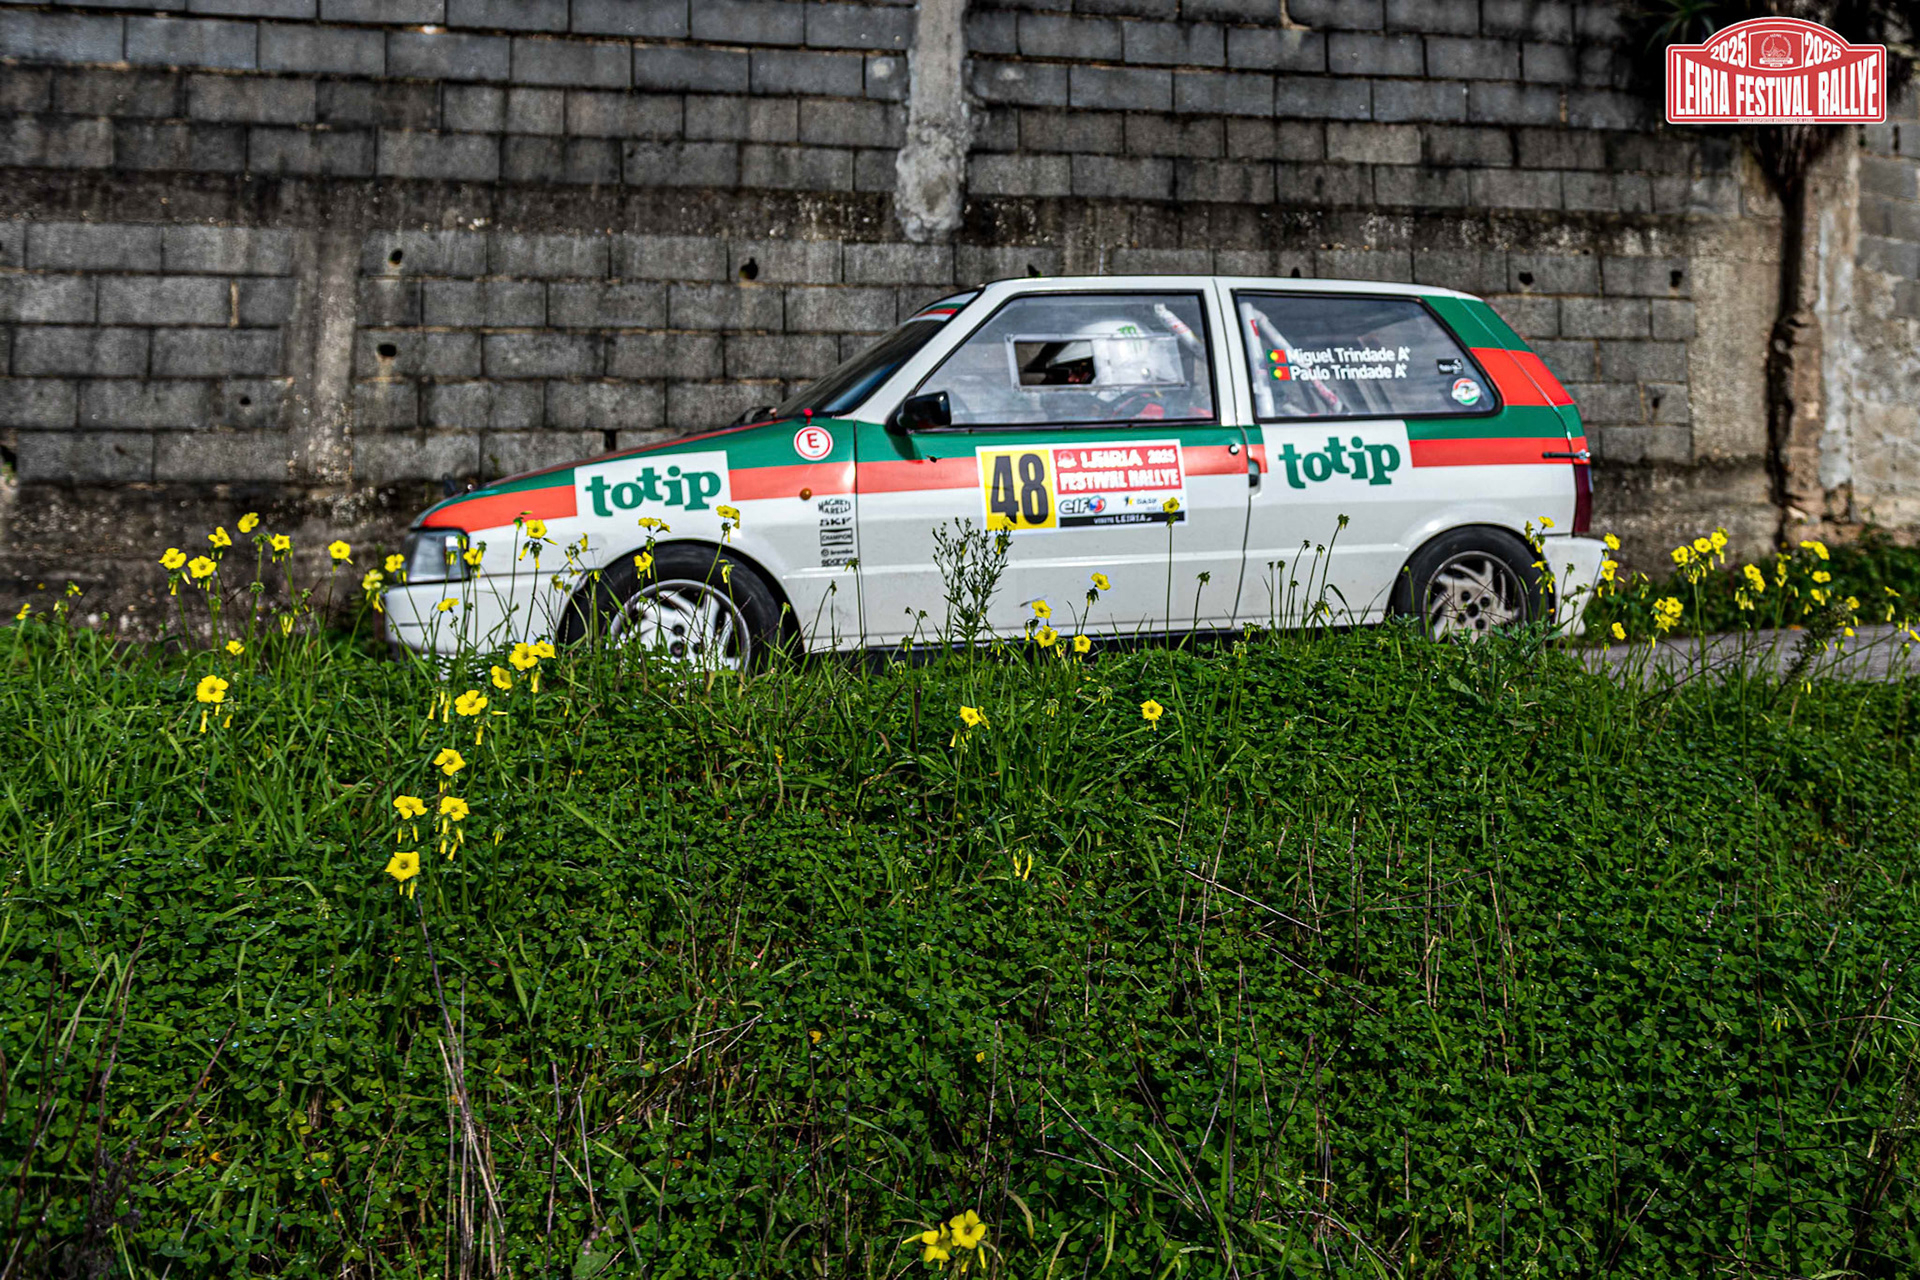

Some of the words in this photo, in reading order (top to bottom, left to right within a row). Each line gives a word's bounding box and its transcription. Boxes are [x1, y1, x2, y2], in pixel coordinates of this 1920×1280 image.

[1286, 347, 1335, 367] Miguel
[1334, 347, 1396, 362] Trindade
[1290, 365, 1330, 381] Paulo
[1331, 364, 1393, 380] Trindade
[806, 433, 820, 449] E
[1080, 449, 1143, 468] LEIRIA
[1147, 448, 1176, 464] 2025
[1278, 436, 1400, 489] totip
[990, 453, 1049, 525] 48
[1059, 470, 1128, 491] FESTIVAL
[1128, 468, 1179, 487] RALLYE
[585, 465, 721, 517] totip
[1059, 498, 1090, 514] elf
[821, 533, 853, 541] CHAMPION
